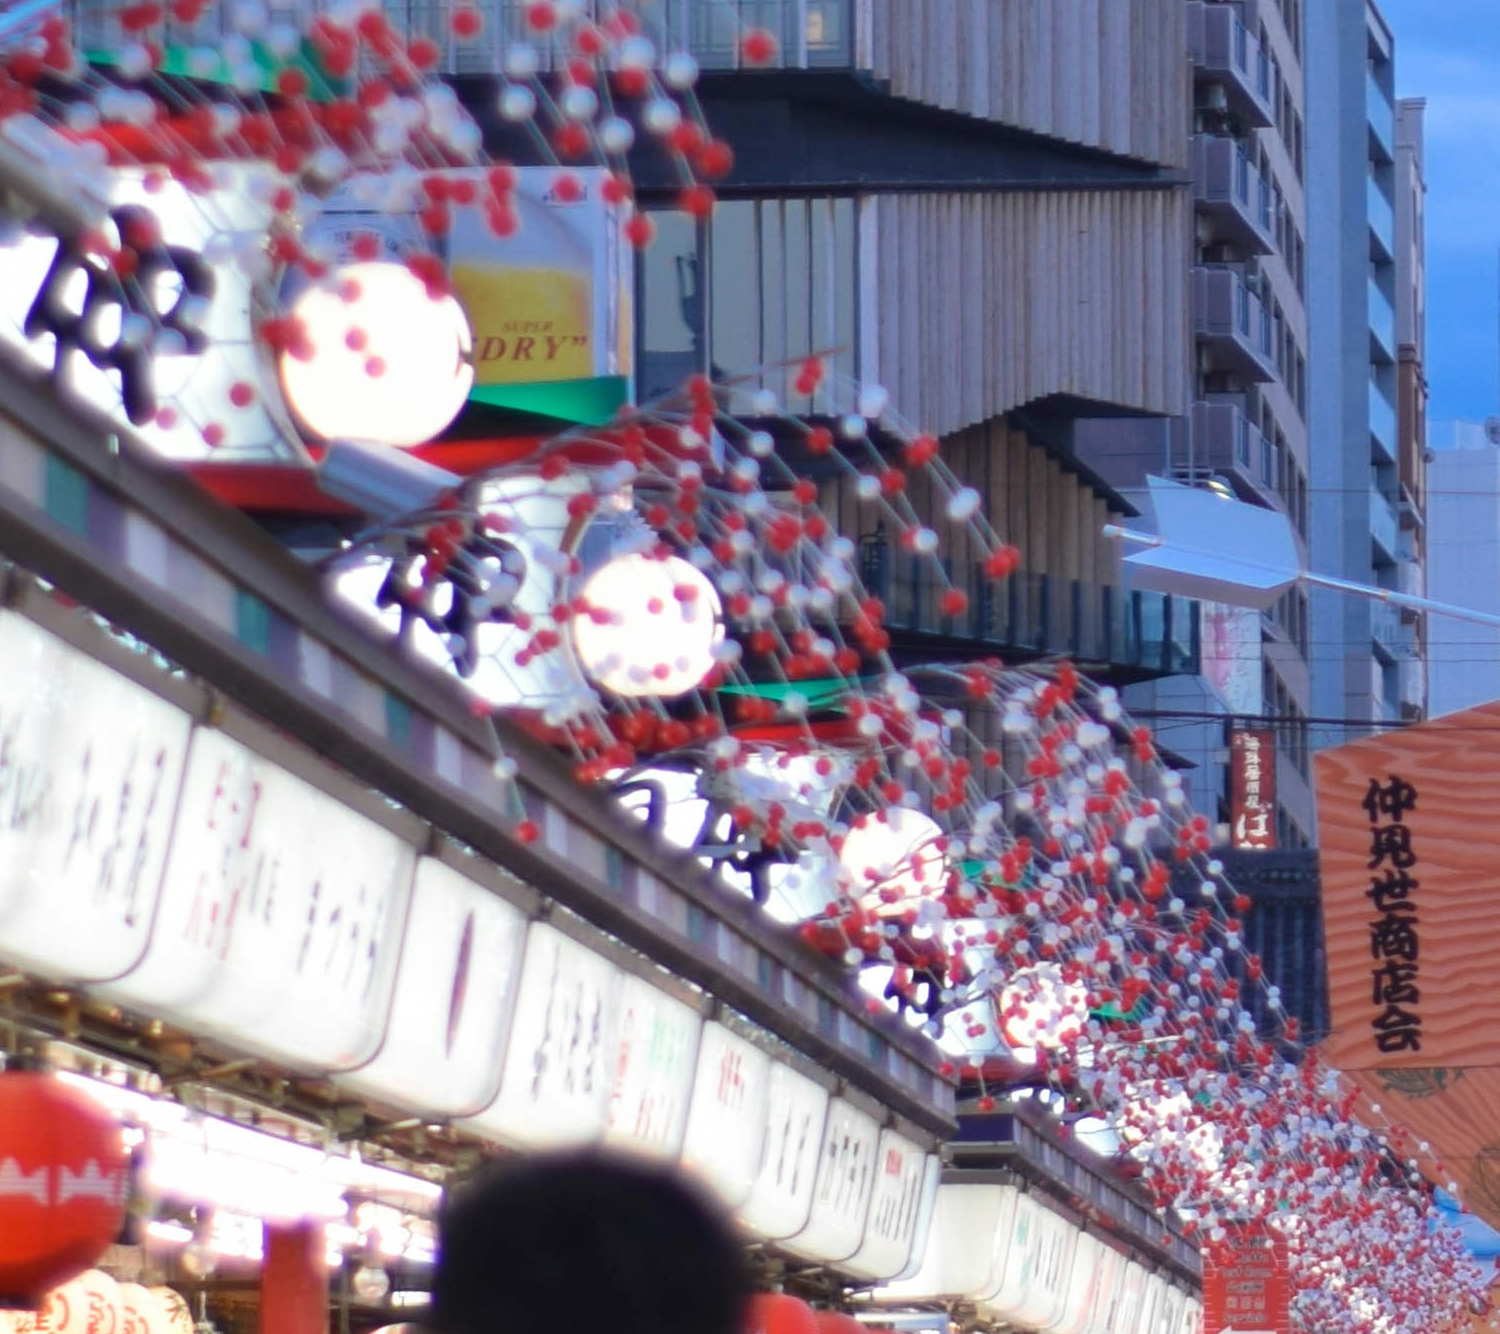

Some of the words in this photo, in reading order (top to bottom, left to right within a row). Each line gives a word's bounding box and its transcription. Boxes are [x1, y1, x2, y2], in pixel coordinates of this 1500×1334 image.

[502, 320, 555, 333] SUPER
[1361, 774, 1423, 1054] 仲見世商店会
